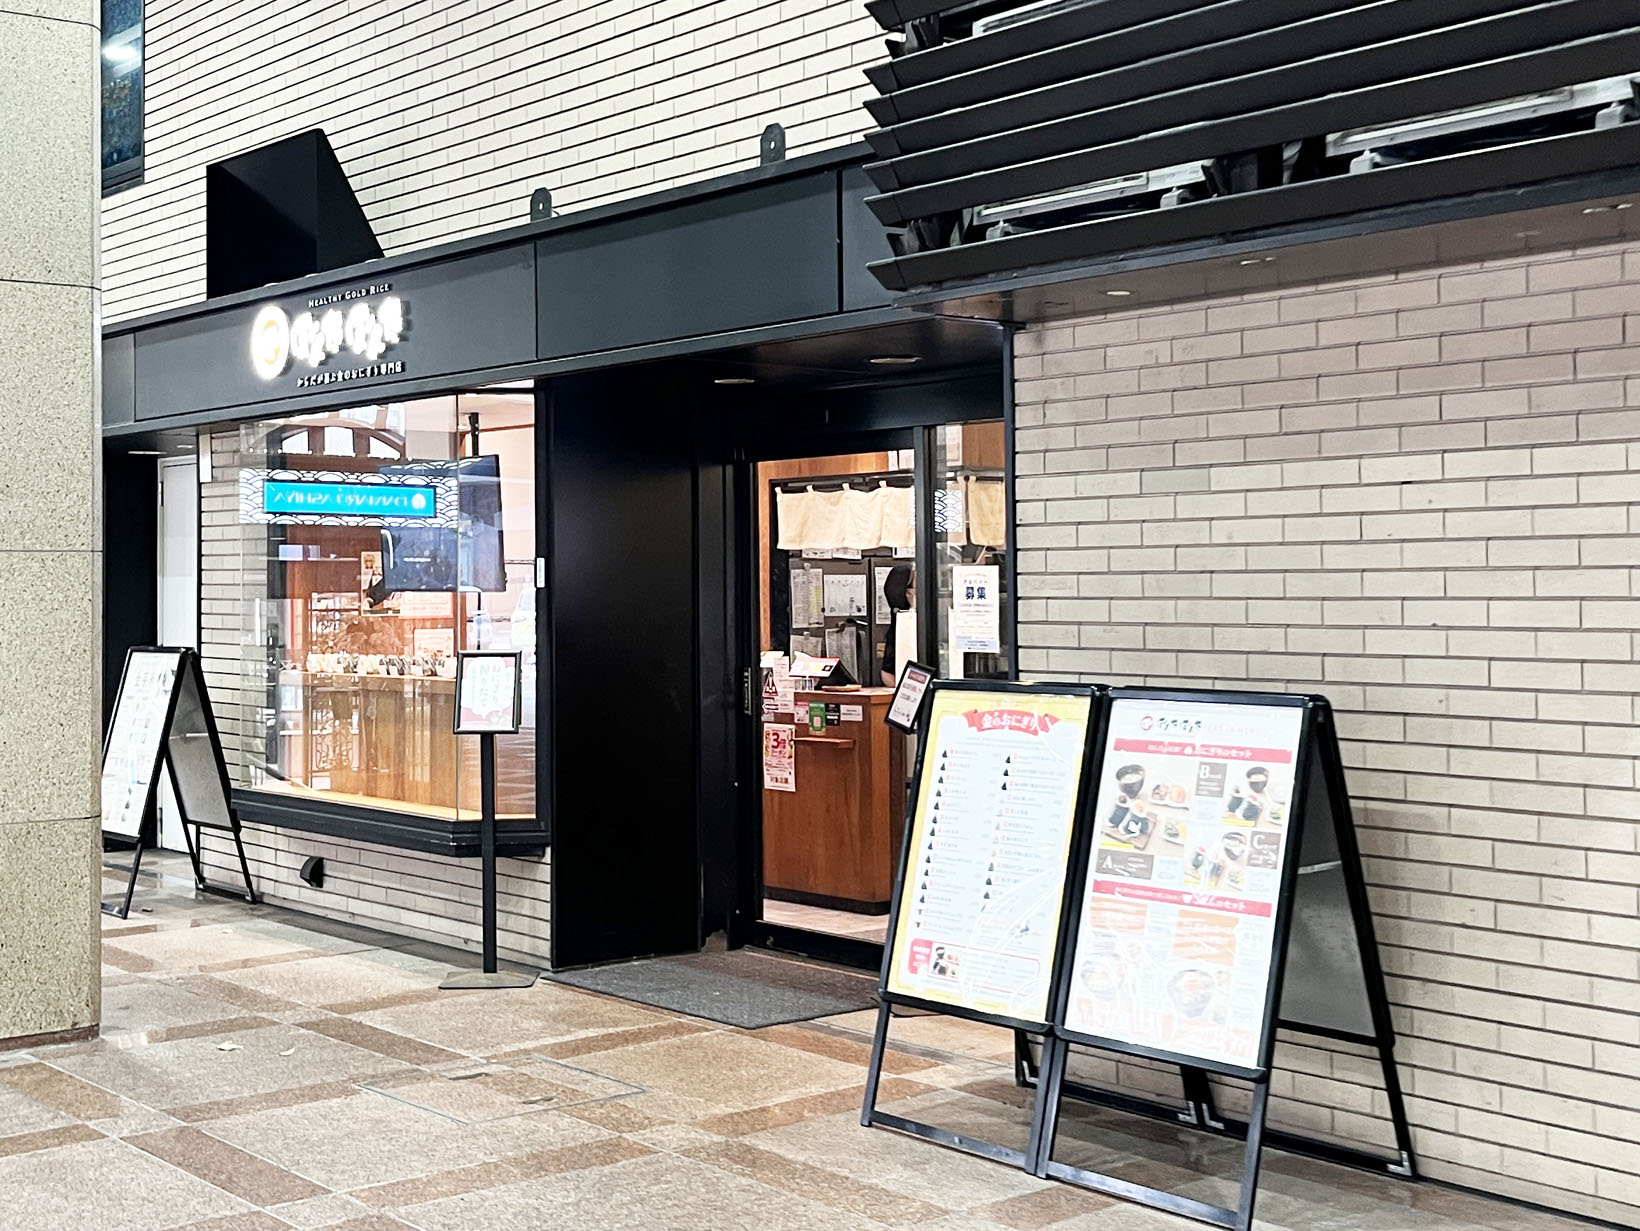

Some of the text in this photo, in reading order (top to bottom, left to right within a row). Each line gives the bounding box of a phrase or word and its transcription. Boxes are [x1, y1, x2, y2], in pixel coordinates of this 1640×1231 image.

[965, 586, 987, 600] 募集
[981, 711, 1037, 731] 金のおにぎり
